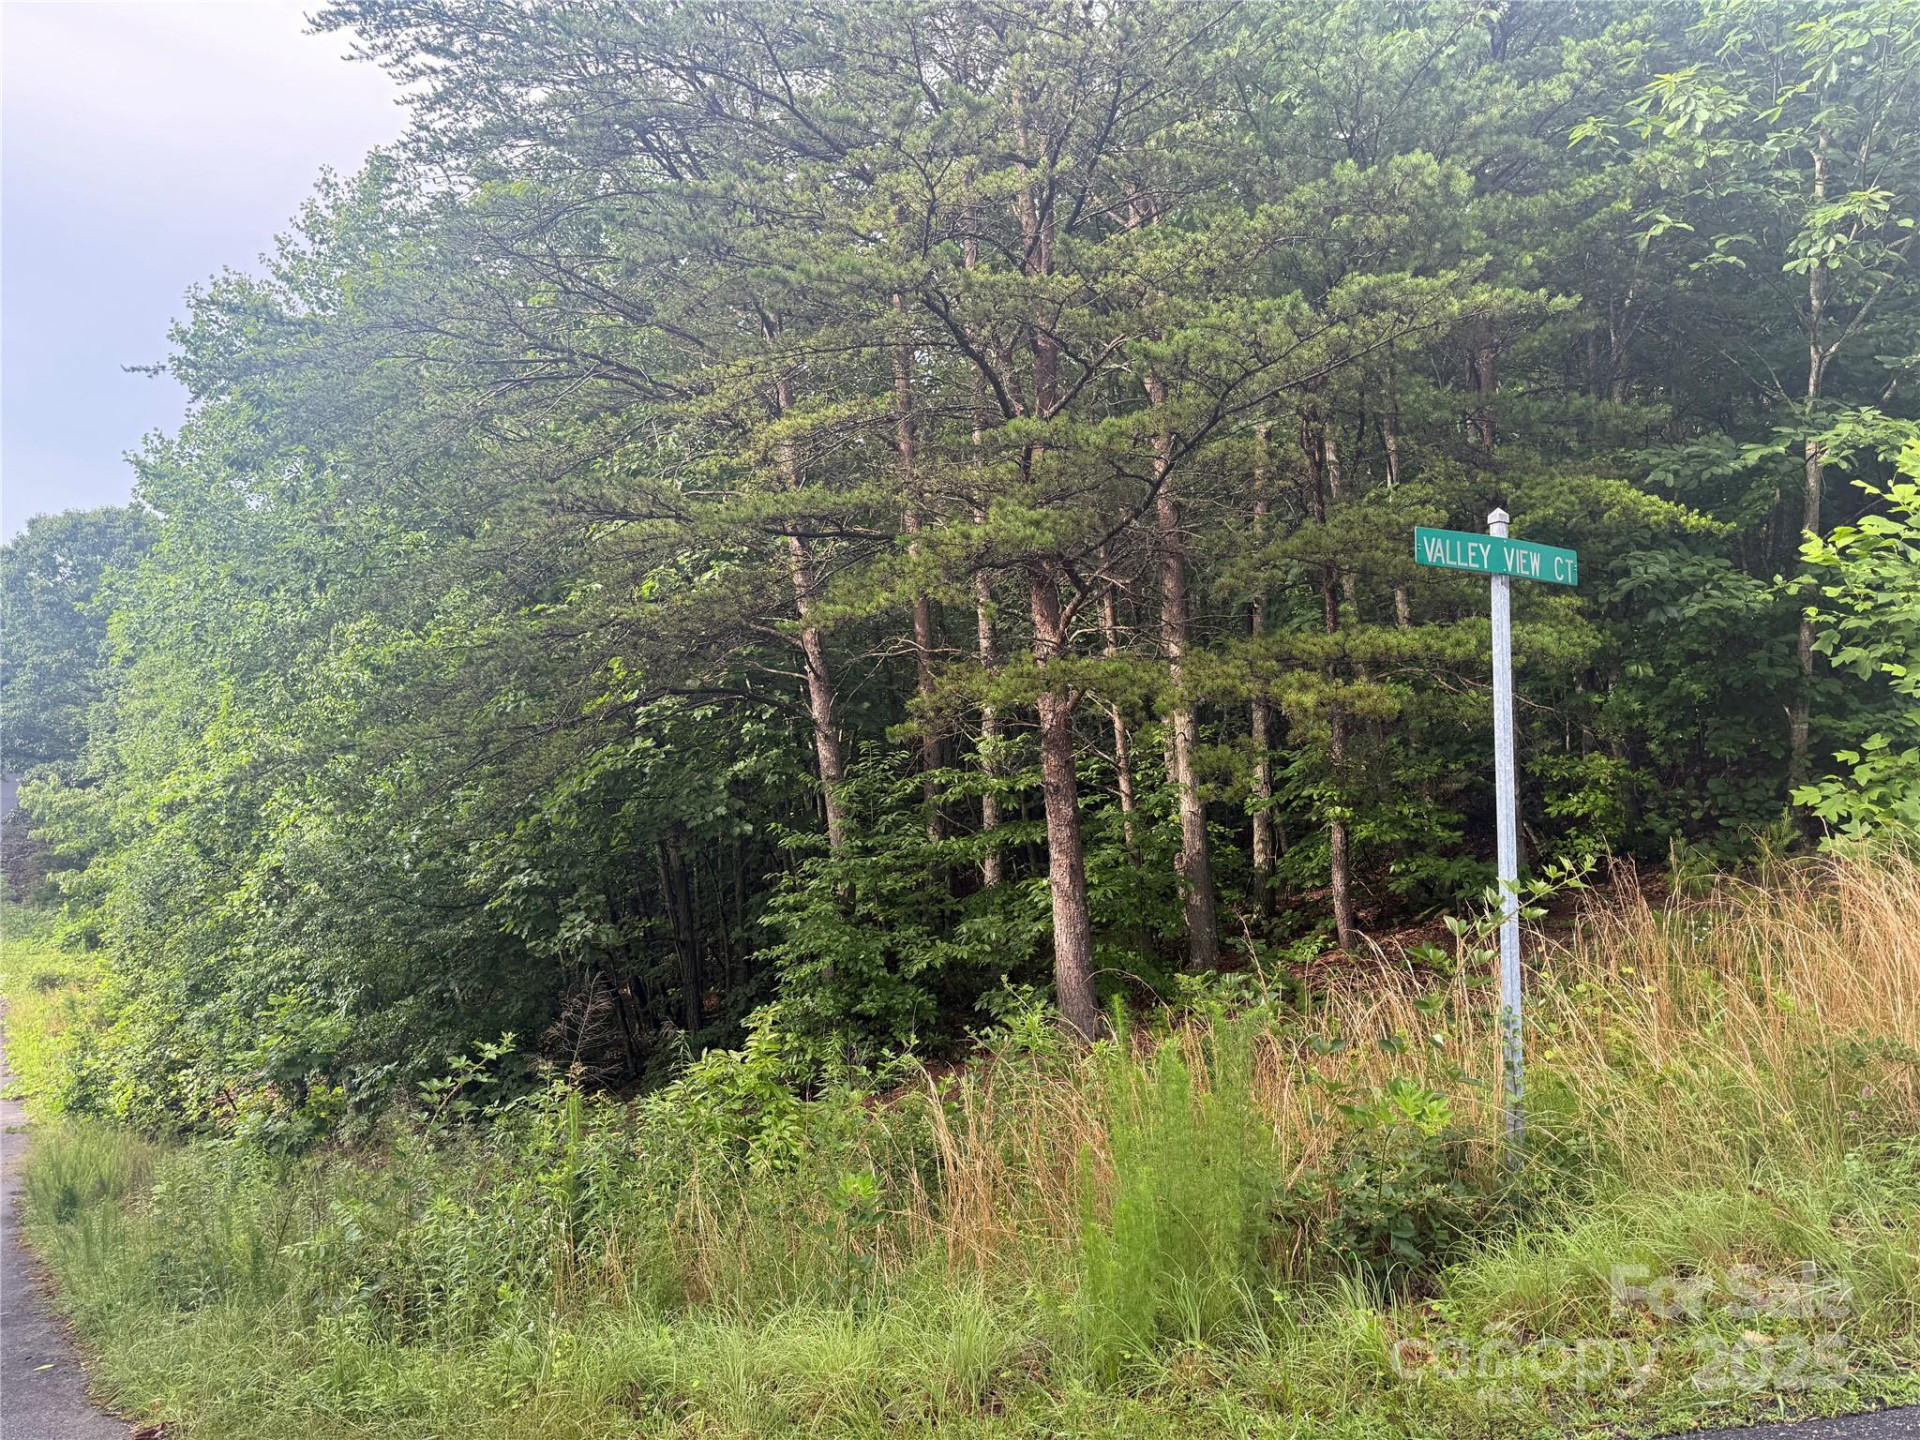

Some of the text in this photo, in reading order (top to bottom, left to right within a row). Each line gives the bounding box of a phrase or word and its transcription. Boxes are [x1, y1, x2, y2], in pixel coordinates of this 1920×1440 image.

[1423, 536, 1574, 583] VALLEY VIEW CT
